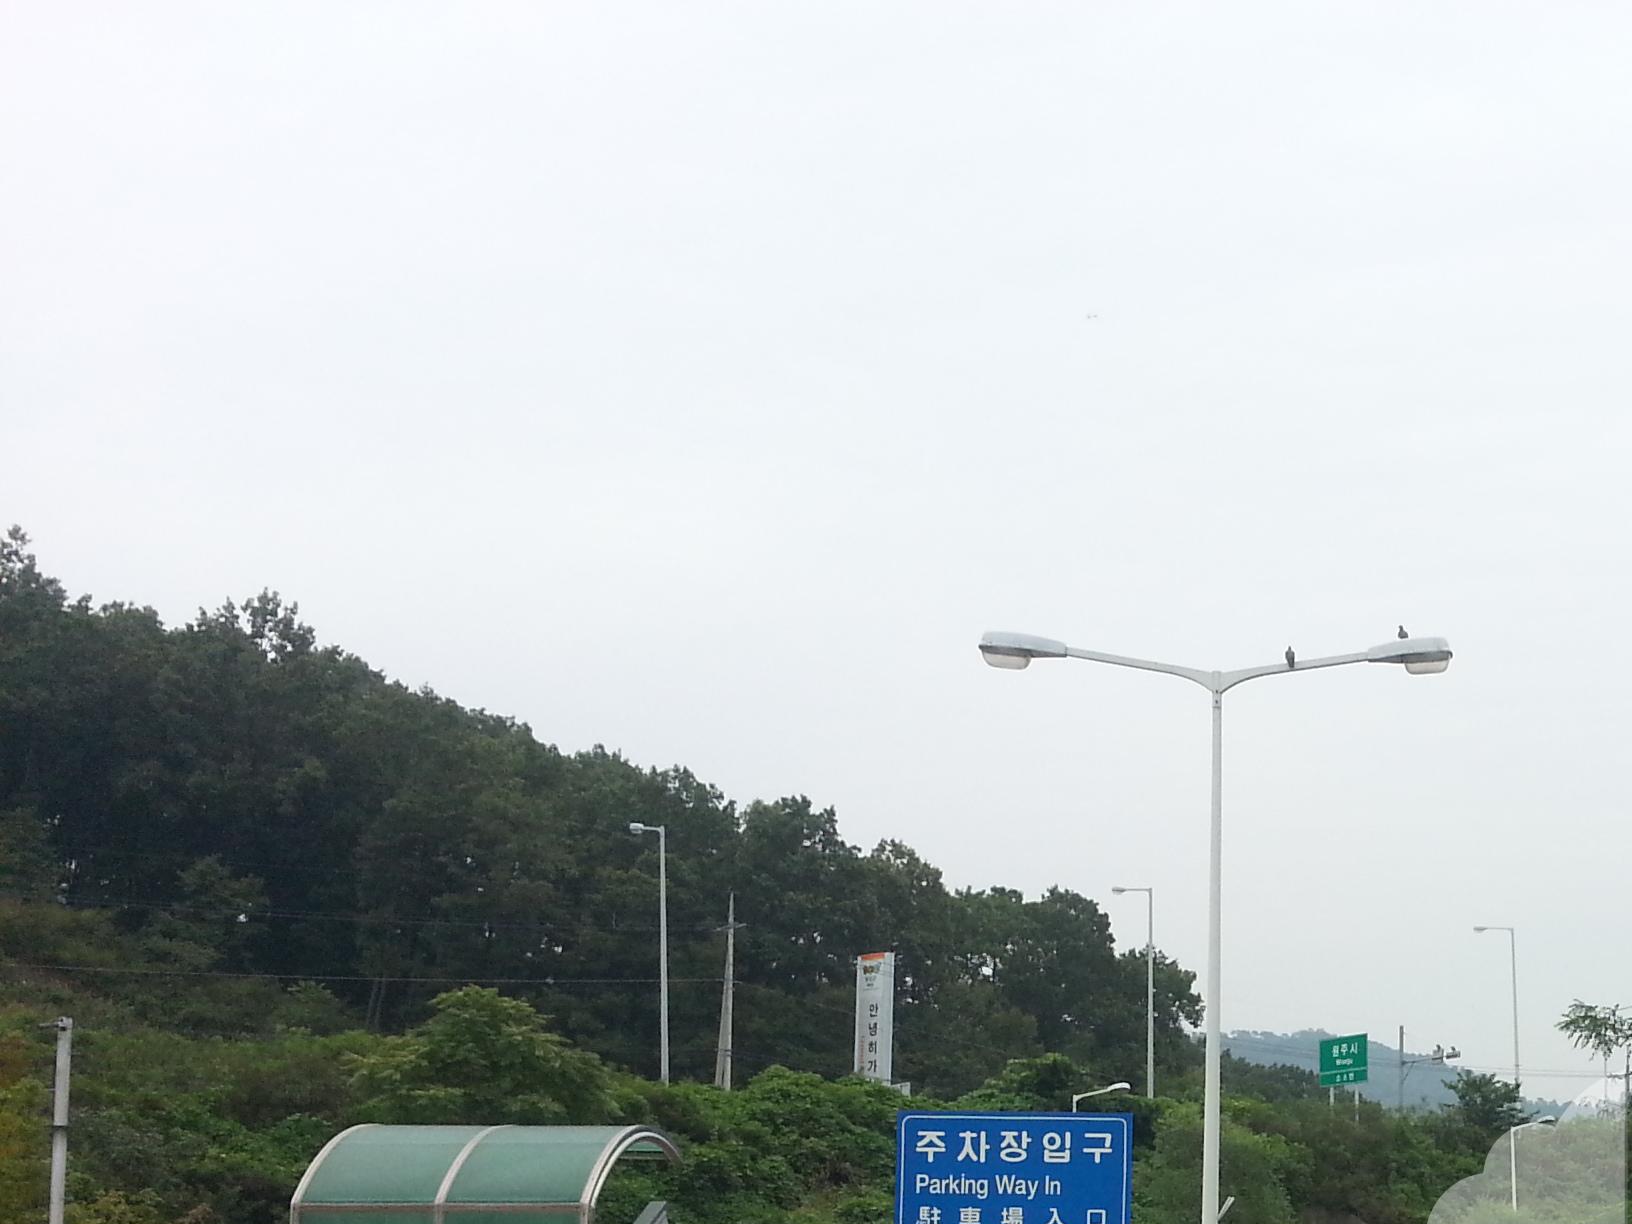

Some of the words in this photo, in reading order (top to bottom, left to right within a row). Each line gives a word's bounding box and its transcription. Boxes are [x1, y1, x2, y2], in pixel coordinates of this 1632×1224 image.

[915, 1131, 1113, 1163] 주차장입구
[915, 1174, 989, 1199] Parking
[995, 1175, 1039, 1199] Way
[1044, 1176, 1061, 1196] In
